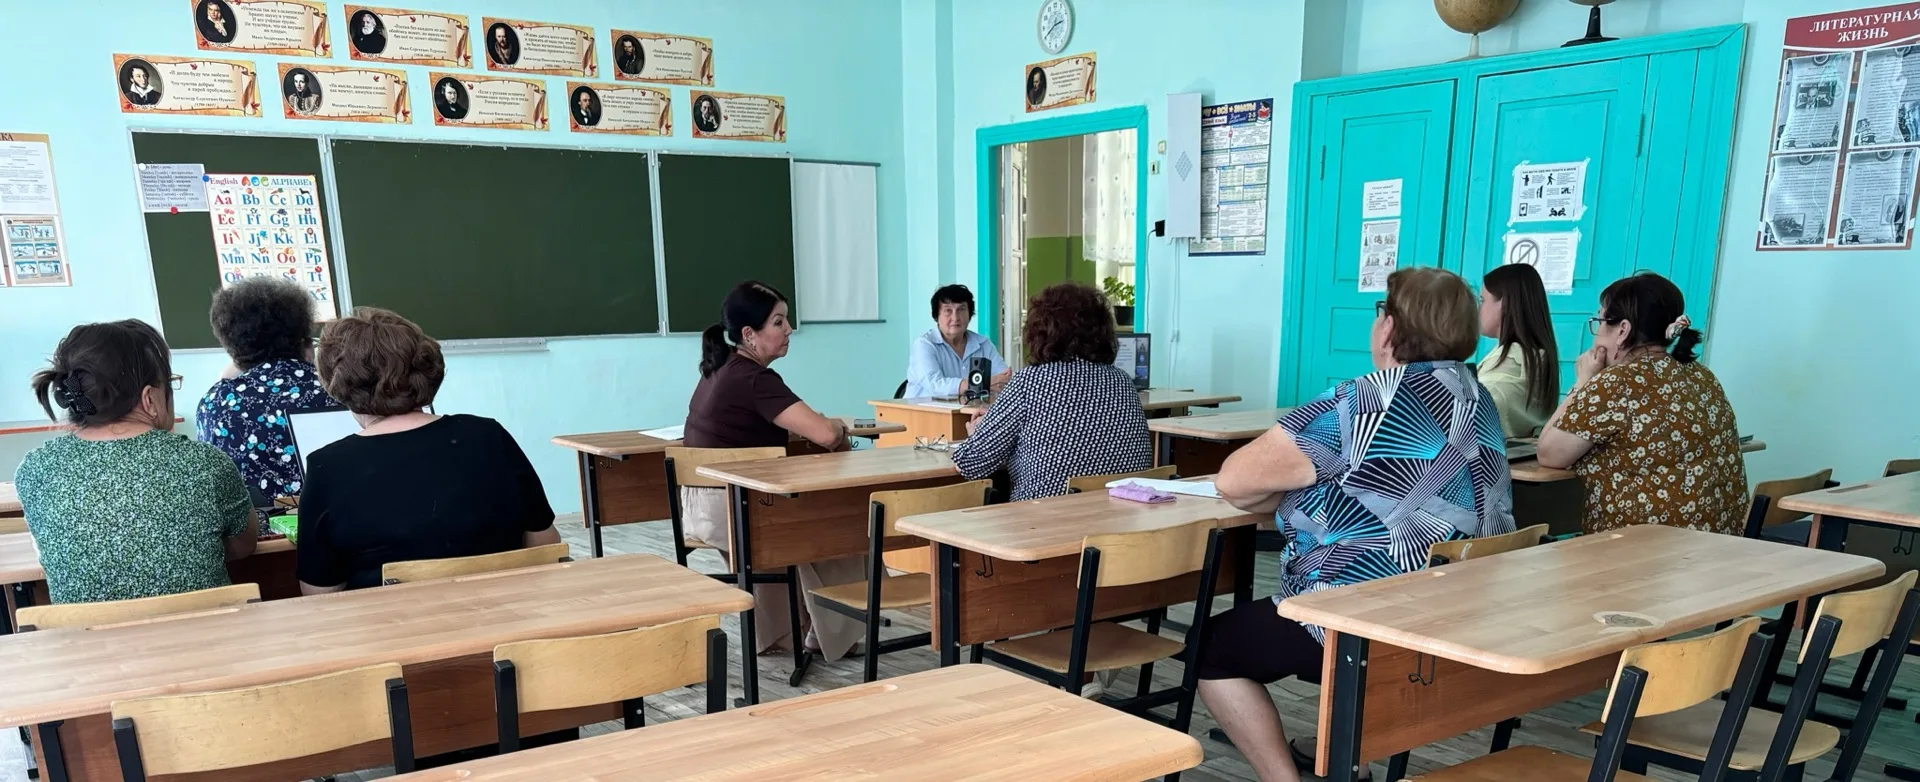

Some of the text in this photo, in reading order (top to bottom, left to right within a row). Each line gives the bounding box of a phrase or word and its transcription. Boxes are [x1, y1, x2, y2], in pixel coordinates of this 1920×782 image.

[1810, 8, 1920, 33] ЛИТЕРАТУРНАЯ
[1837, 27, 1889, 43] ЖИЗНЬ
[0, 132, 14, 141] КА
[210, 178, 238, 186] English
[214, 194, 233, 205] Aa
[242, 194, 261, 205] Bb
[269, 194, 287, 206] Cc
[296, 194, 314, 206] Dd
[218, 214, 236, 225] Ee
[247, 214, 261, 225] Ff
[270, 214, 289, 228] Gg
[298, 214, 317, 225] Hh
[223, 233, 234, 245] Ii
[248, 233, 261, 247] Jj
[274, 233, 294, 245] Kk
[221, 253, 245, 264] Mm
[251, 253, 270, 264] Nn
[277, 252, 296, 264] Oo
[305, 252, 322, 266] Pp
[307, 271, 323, 282] Tt
